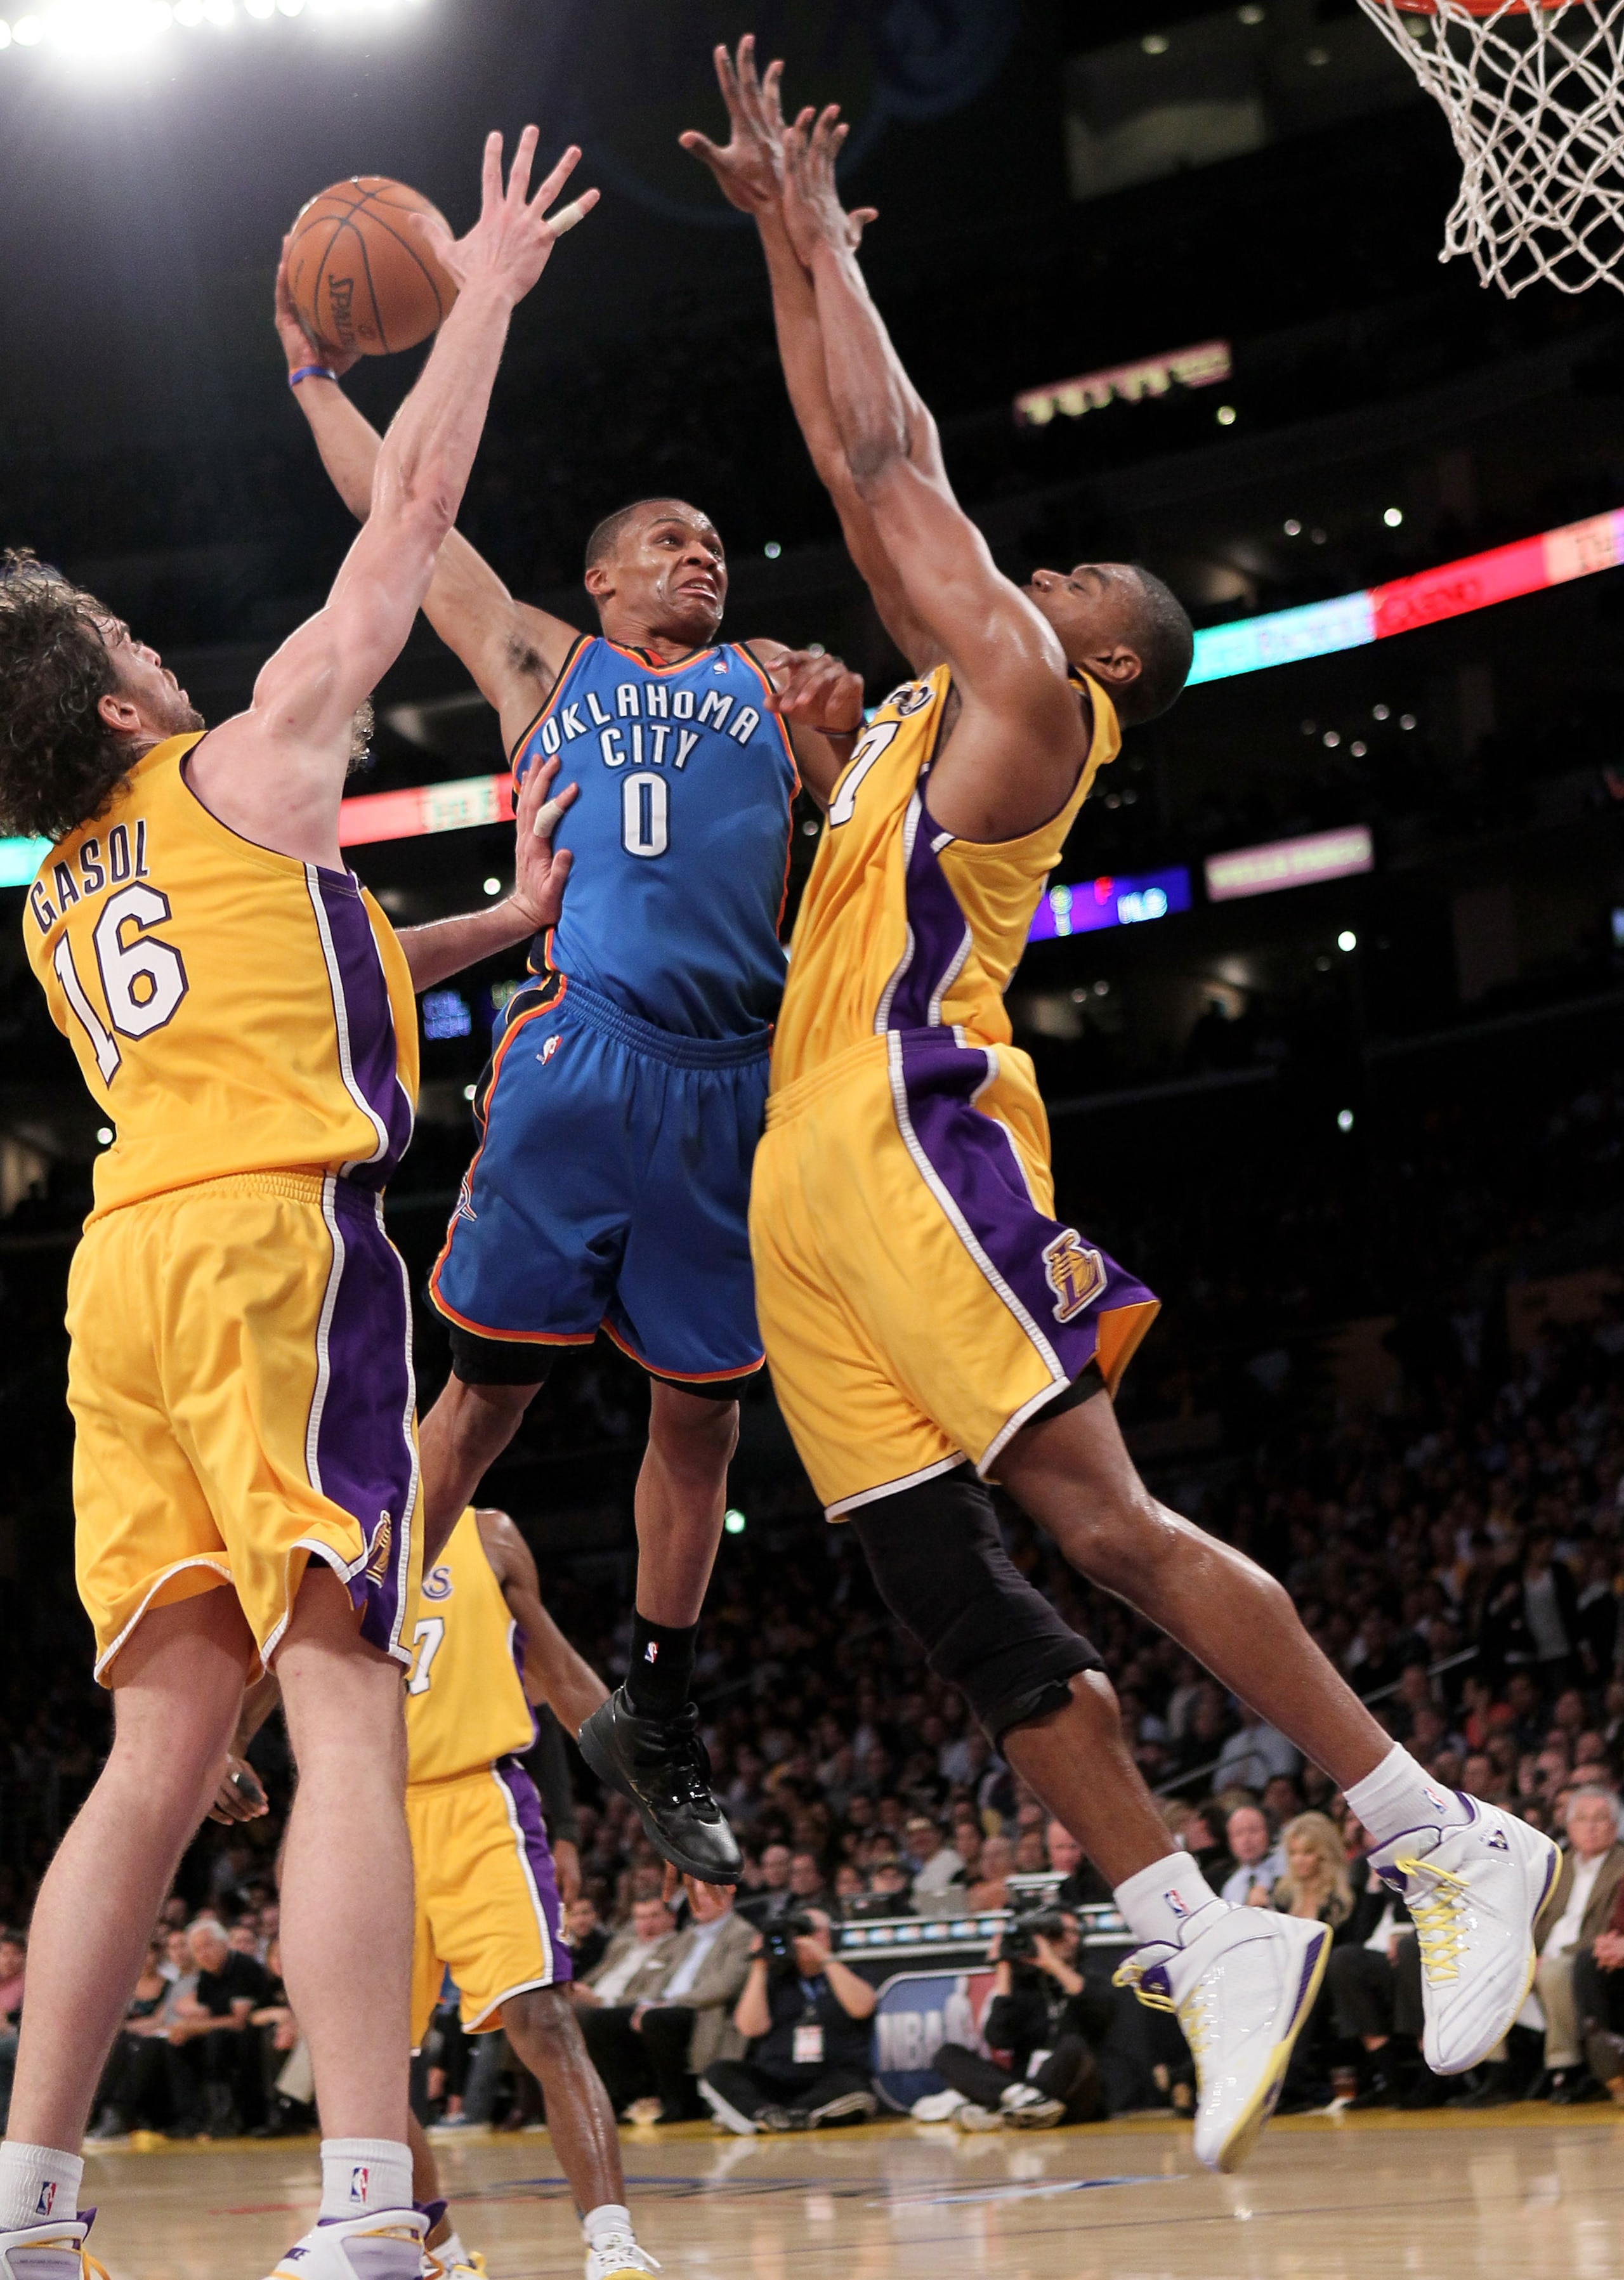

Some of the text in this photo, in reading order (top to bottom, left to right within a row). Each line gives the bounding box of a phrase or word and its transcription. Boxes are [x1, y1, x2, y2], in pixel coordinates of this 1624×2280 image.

[540, 682, 761, 757] OKLAHOMA
[599, 724, 702, 770] CITY
[621, 770, 670, 859] 0
[30, 819, 151, 936] GASOL
[53, 881, 190, 1090] 16
[408, 1616, 445, 1696] 7
[877, 2010, 943, 2071] NBA
